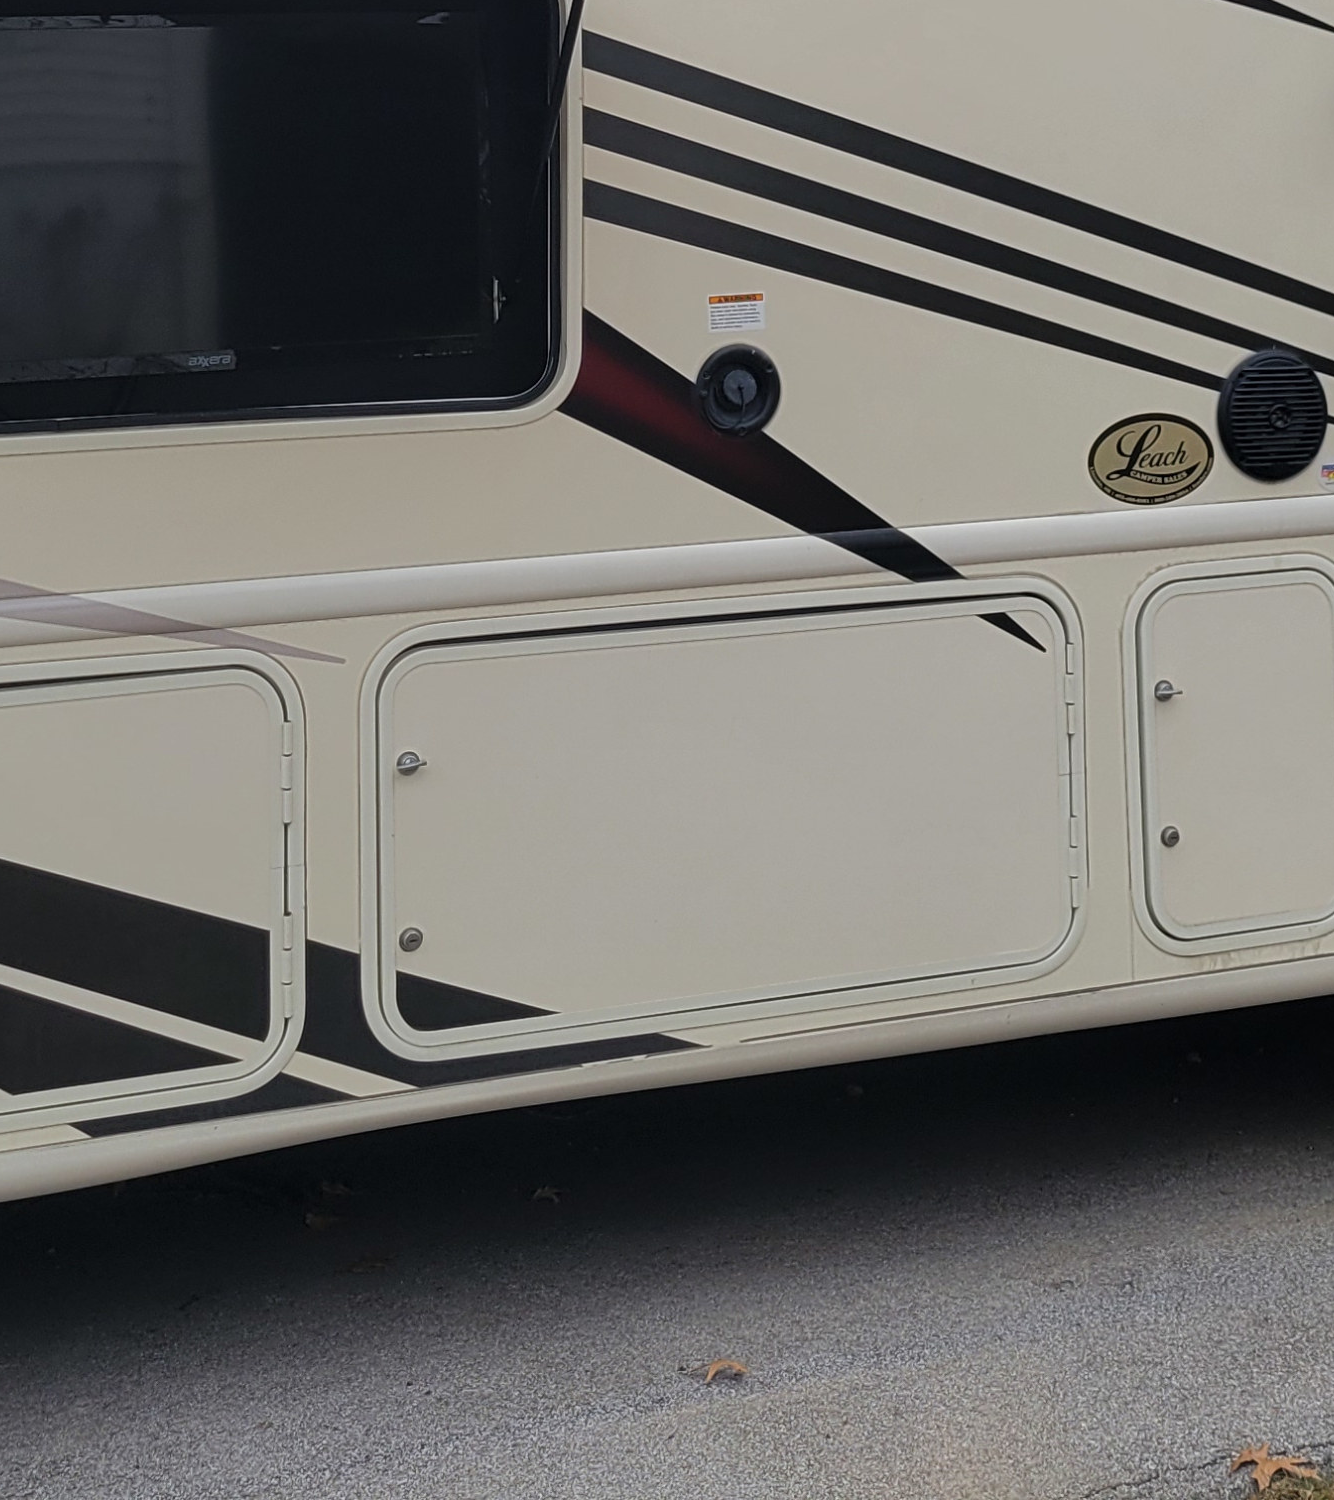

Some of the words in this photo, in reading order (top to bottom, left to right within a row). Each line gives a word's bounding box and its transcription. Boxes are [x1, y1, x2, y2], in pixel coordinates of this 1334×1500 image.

[1105, 424, 1189, 481] Leach
[1129, 469, 1163, 484] CAMPER
[1163, 471, 1188, 484] SALES
